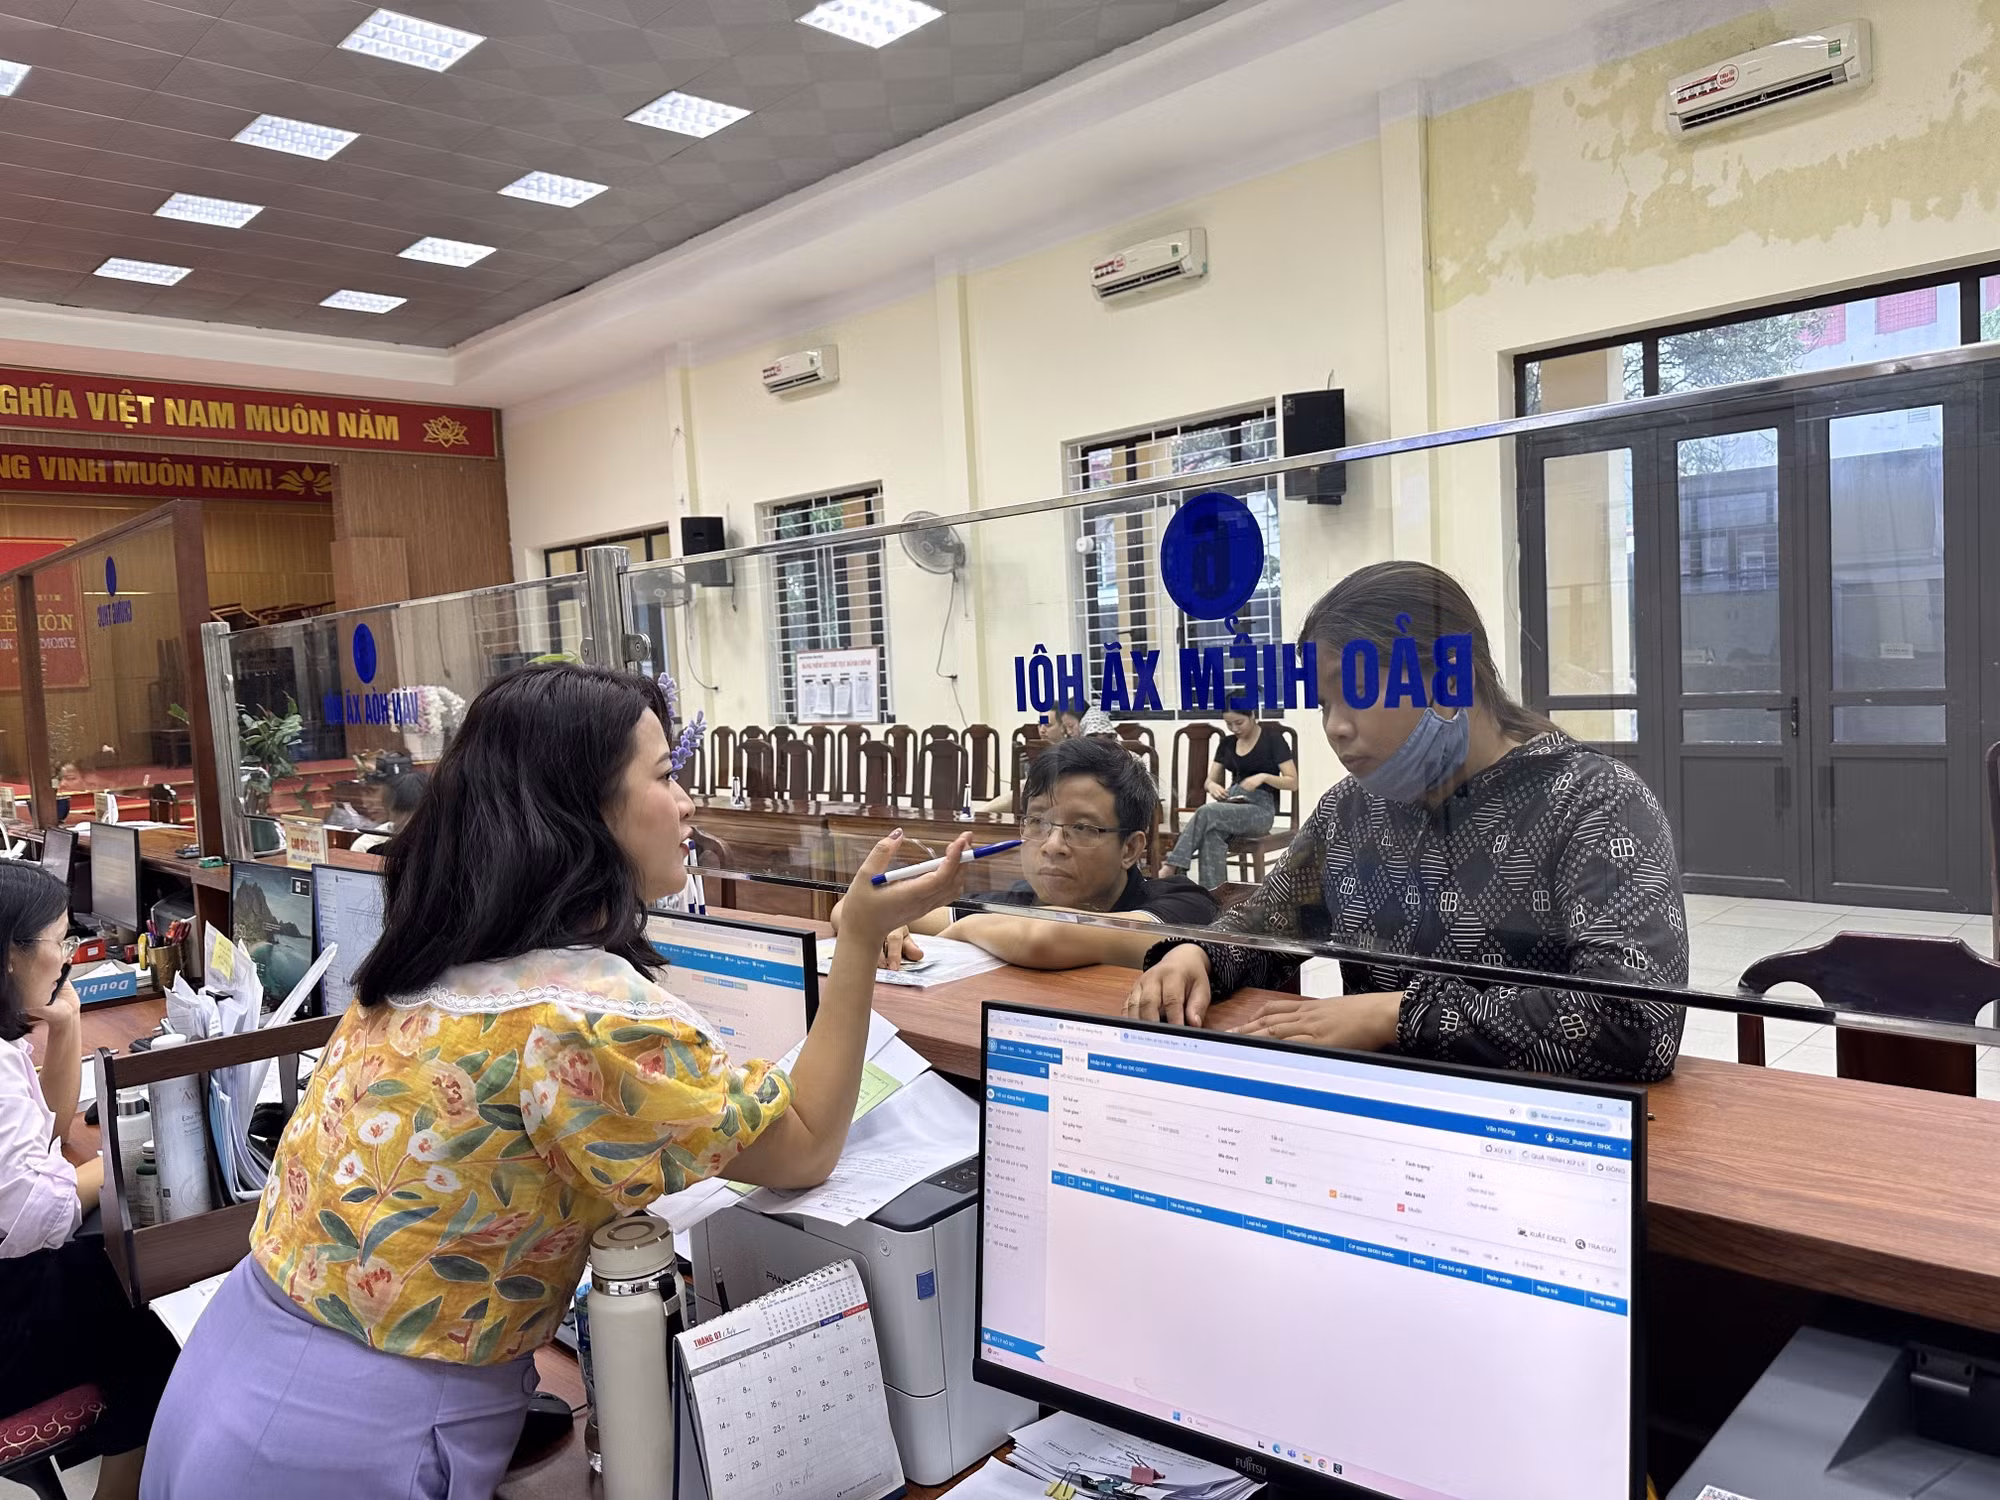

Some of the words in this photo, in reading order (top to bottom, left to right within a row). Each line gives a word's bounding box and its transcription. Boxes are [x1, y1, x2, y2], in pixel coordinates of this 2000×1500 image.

[85, 388, 155, 429] VIỆT
[163, 397, 236, 430] NAM
[244, 402, 330, 436] MUÔN
[337, 408, 400, 441] NĂM
[38, 455, 107, 483] VINH
[112, 456, 195, 487] MUÔN
[202, 461, 273, 490] NĂM!
[76, 980, 129, 996] Double
[713, 1331, 722, 1340] 07
[861, 1337, 867, 1345] 13
[839, 1346, 845, 1354] 12
[791, 1365, 798, 1373] 10
[864, 1361, 871, 1369] 20
[843, 1369, 850, 1377] 19
[868, 1383, 874, 1392] 27
[796, 1389, 801, 1397] 17
[846, 1393, 853, 1401] 26
[771, 1400, 777, 1408] 16
[822, 1403, 830, 1412] 25
[745, 1411, 751, 1419] 15
[798, 1414, 806, 1422] 24
[719, 1422, 726, 1430] 14
[773, 1424, 781, 1434] 23
[748, 1435, 756, 1445] 22
[803, 1437, 810, 1446] 31
[723, 1447, 729, 1456] 21
[777, 1448, 784, 1458] 30
[751, 1460, 759, 1470] 29
[1235, 1456, 1267, 1476] FUJITSU
[725, 1472, 733, 1482] 28
